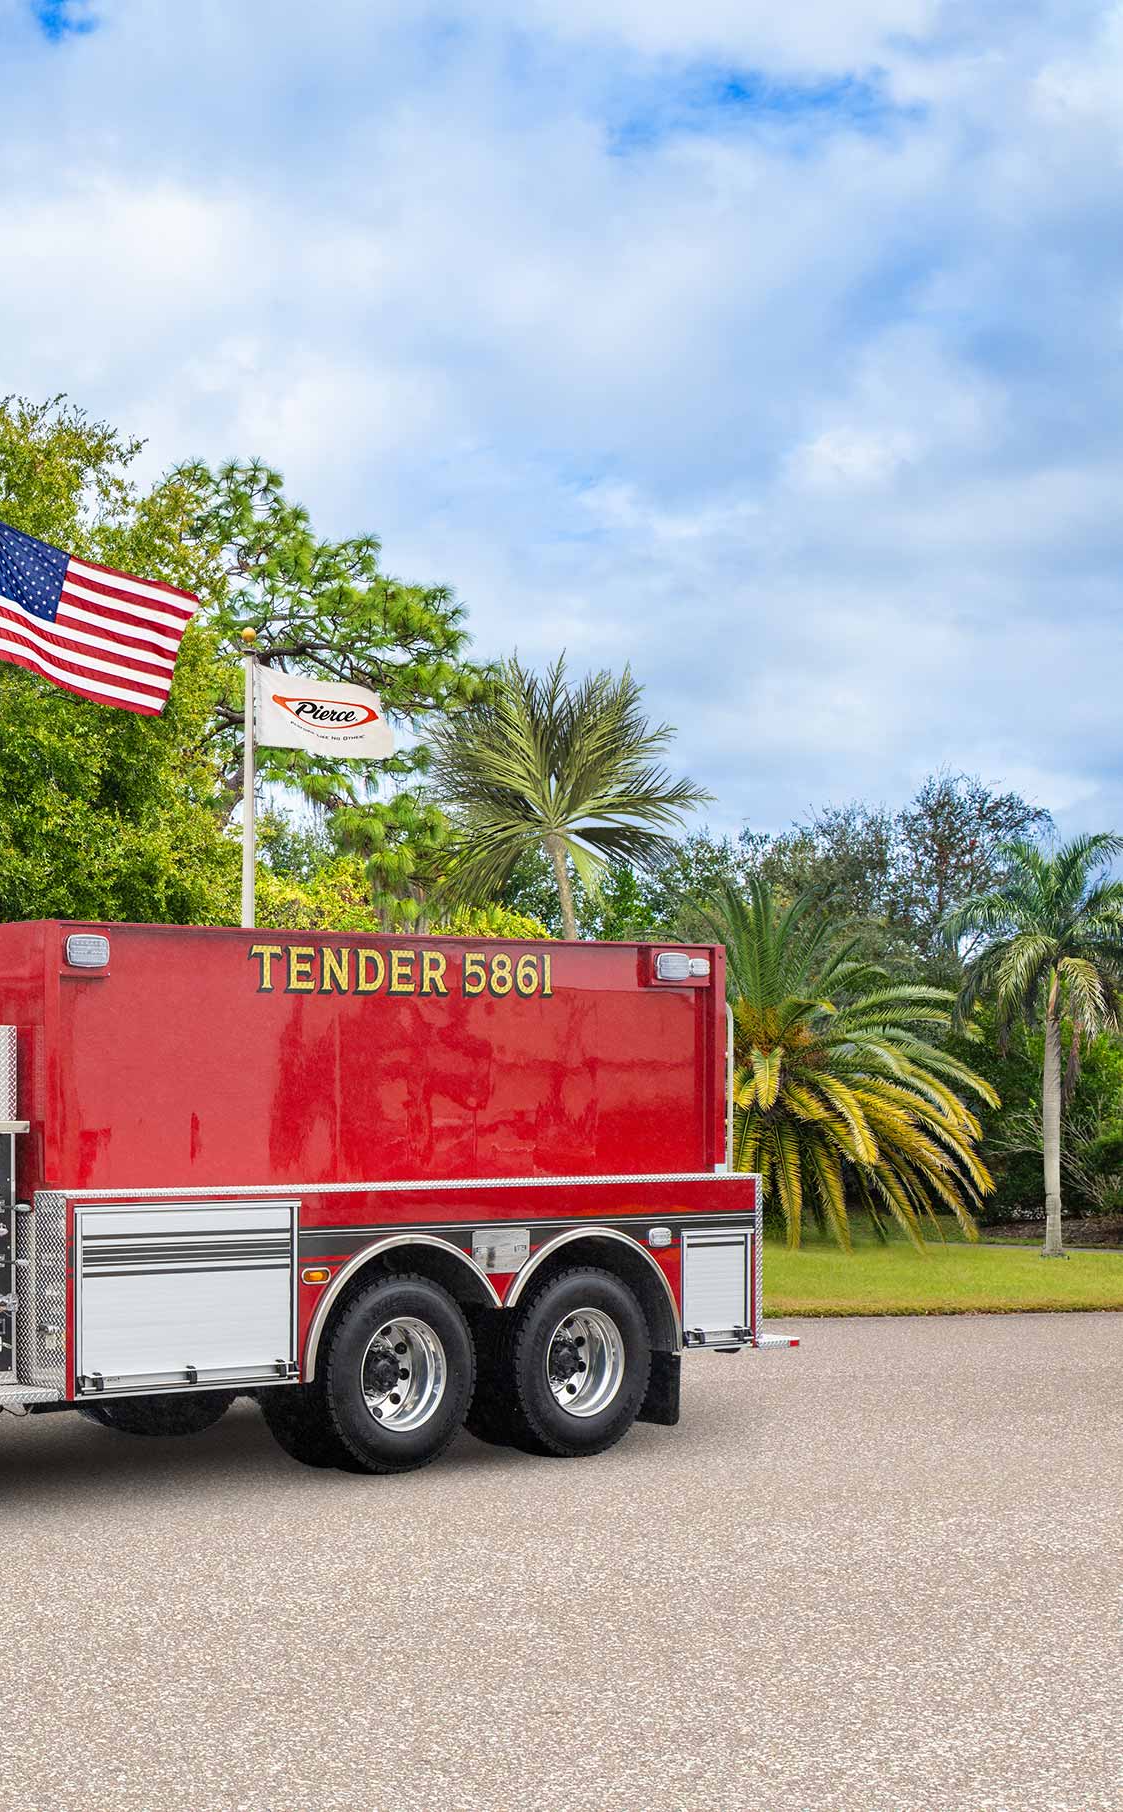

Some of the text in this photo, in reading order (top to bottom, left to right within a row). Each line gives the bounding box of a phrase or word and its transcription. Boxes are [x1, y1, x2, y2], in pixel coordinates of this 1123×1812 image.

[295, 702, 357, 722] Pierce
[248, 944, 554, 998] TENDER 5861
